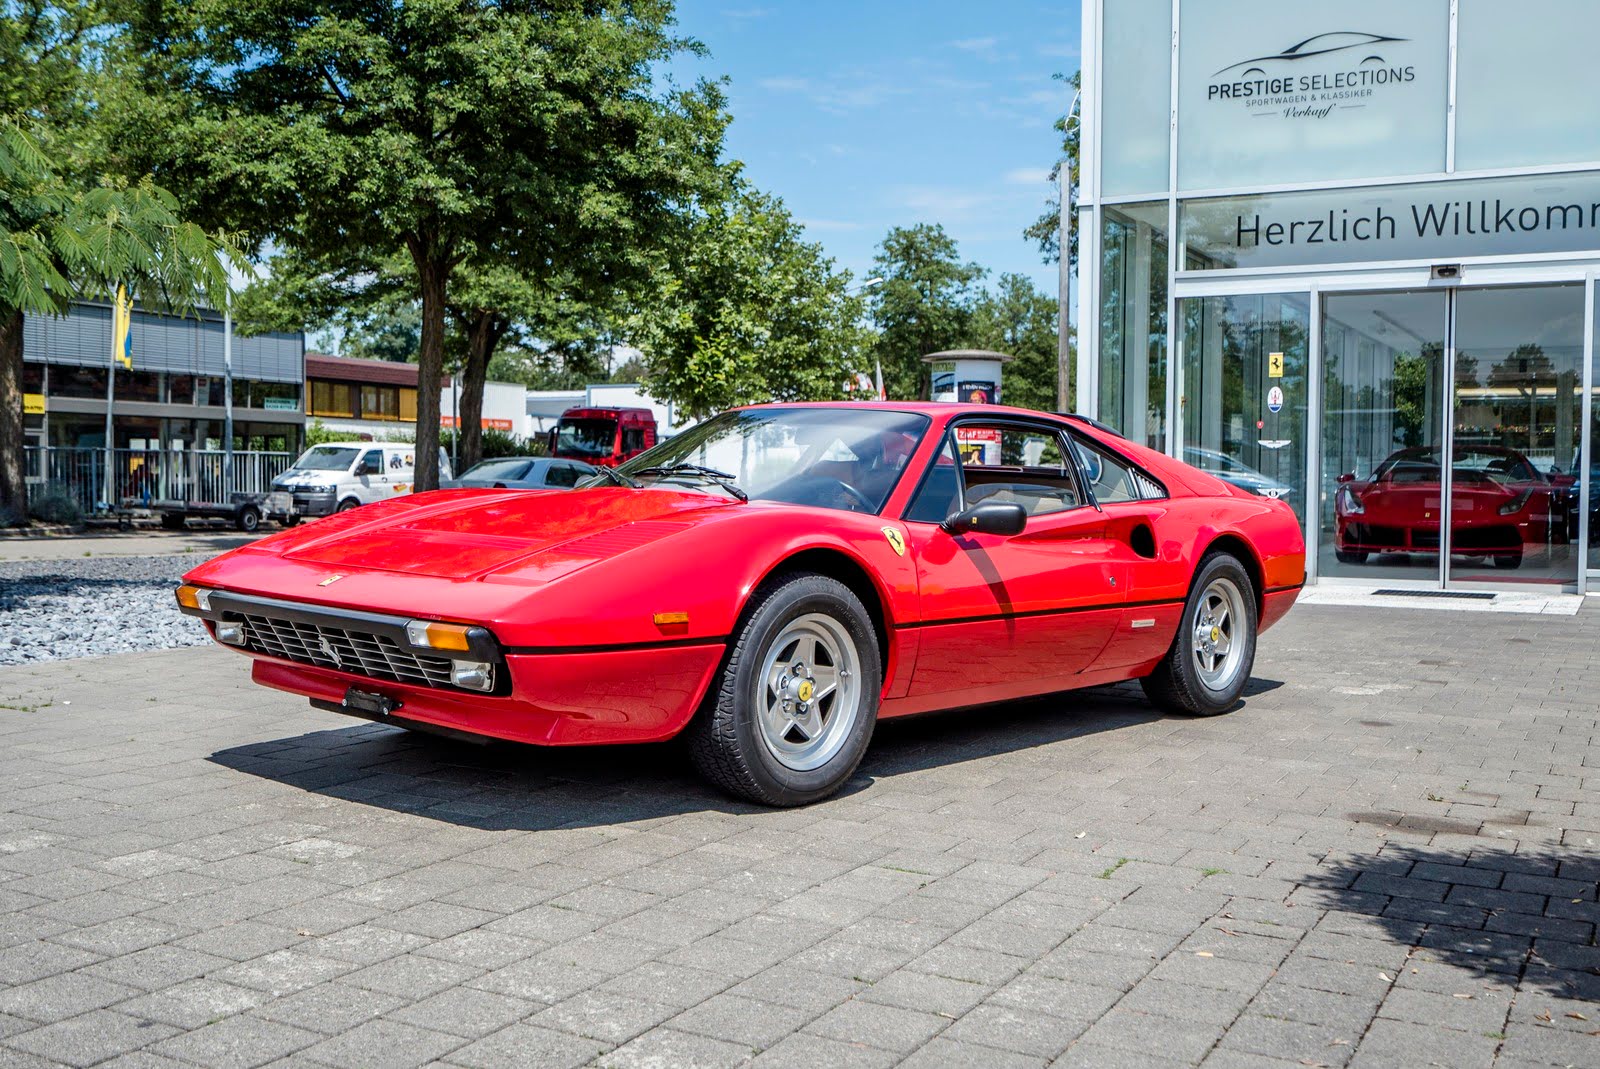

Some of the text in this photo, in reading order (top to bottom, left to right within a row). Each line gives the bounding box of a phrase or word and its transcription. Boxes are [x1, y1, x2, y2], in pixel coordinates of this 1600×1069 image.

[1208, 66, 1415, 100] PRESTIGE SELECTIONS
[1246, 94, 1307, 108] SPORTWAGEN
[1320, 89, 1373, 101] KLASSIKER
[1283, 103, 1337, 119] Verkauf
[1237, 199, 1600, 247] Herzlich Willkom
